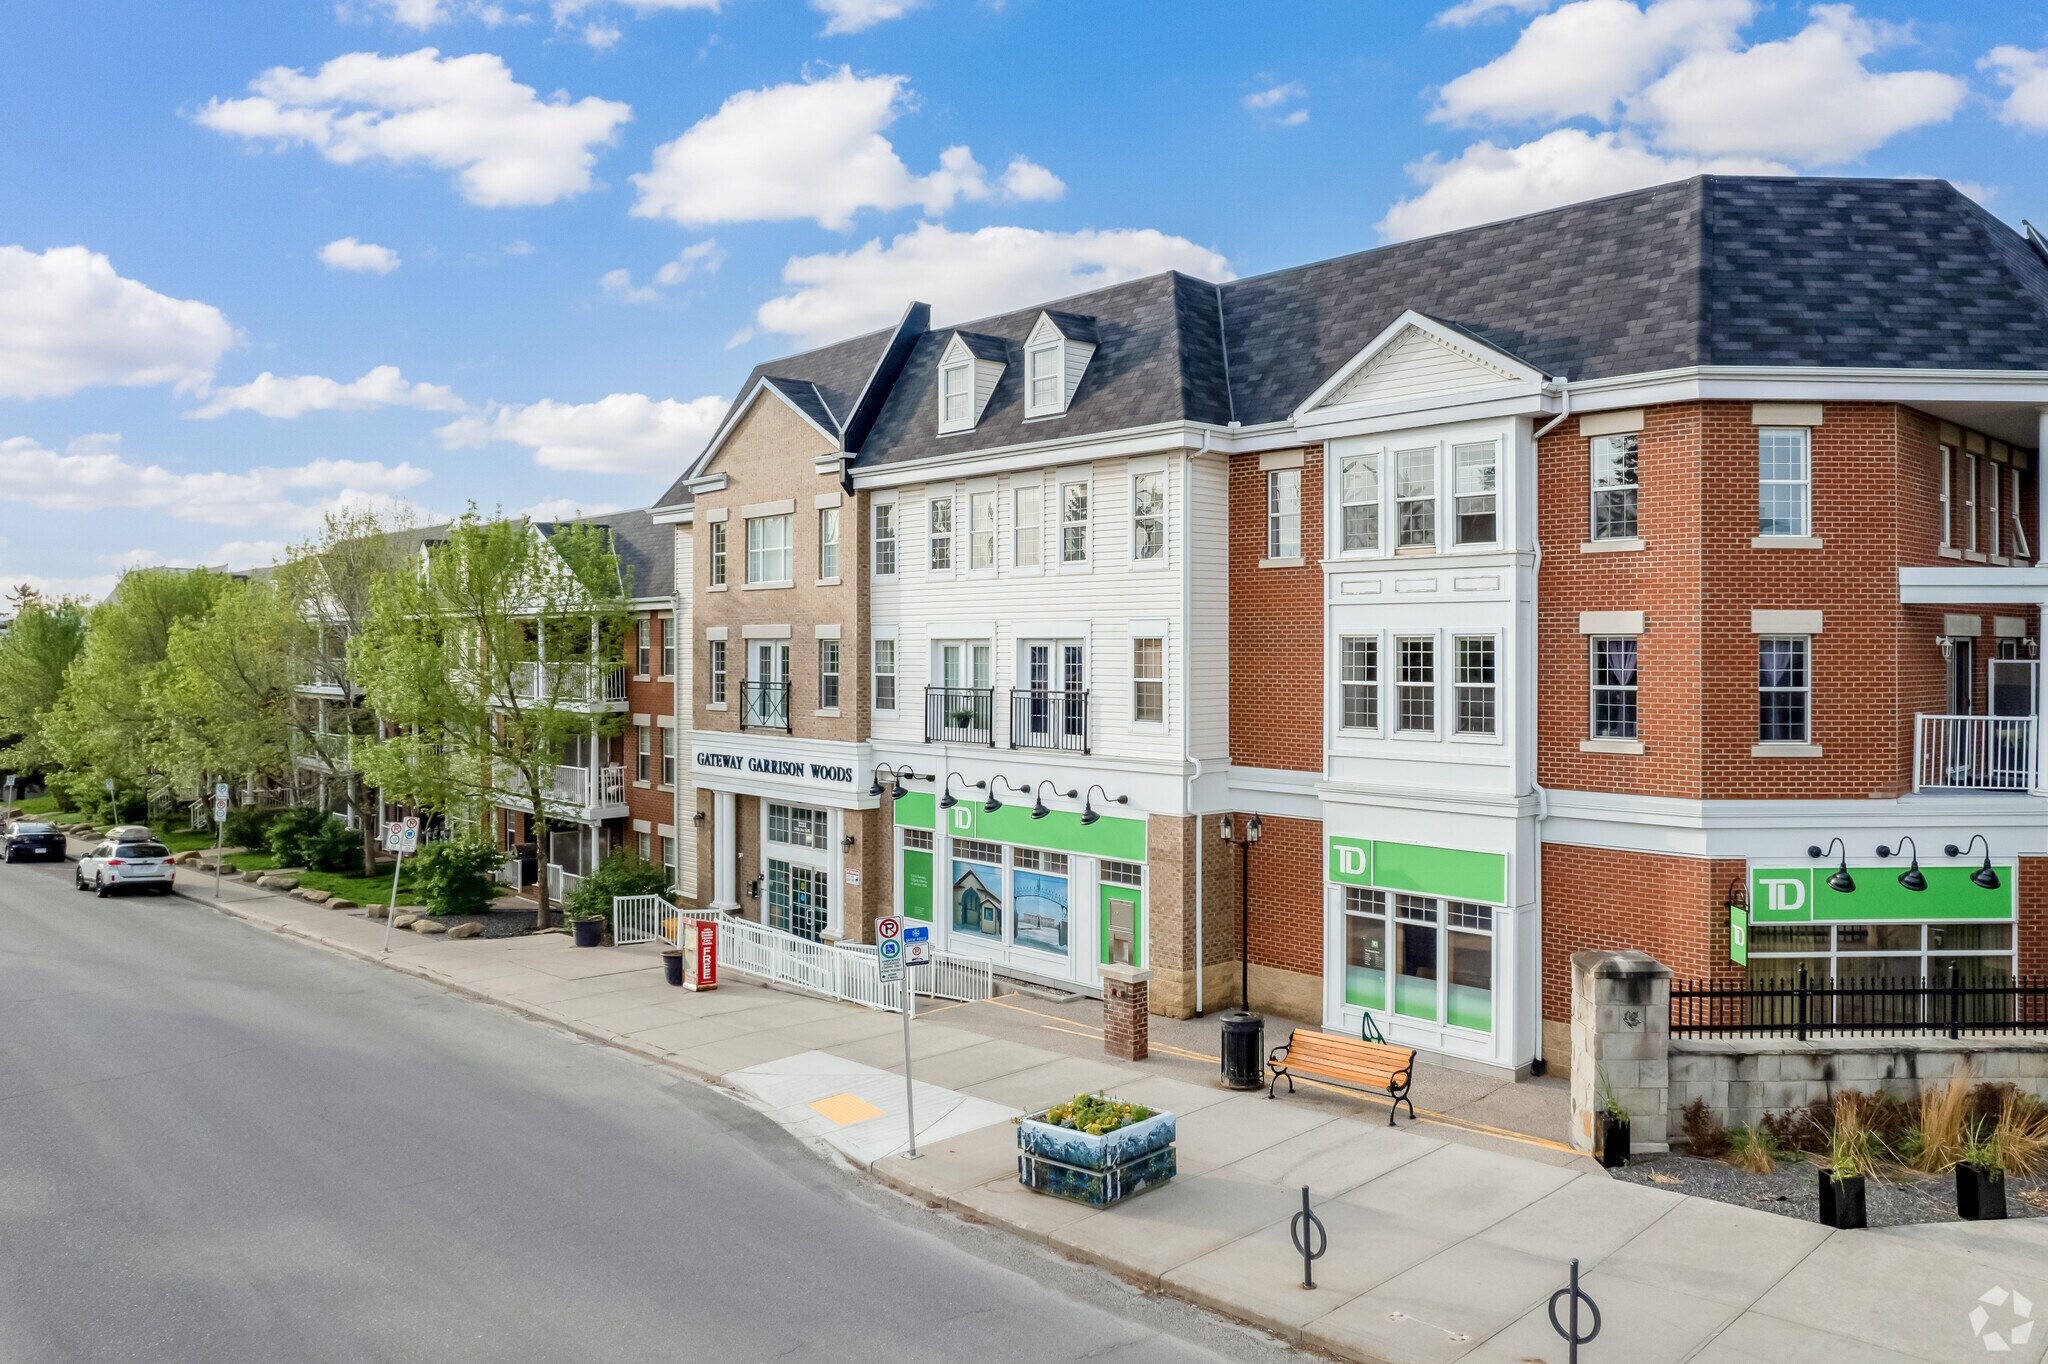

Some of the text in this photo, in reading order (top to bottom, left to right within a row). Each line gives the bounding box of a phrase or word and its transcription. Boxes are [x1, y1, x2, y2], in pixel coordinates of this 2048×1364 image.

[697, 752, 853, 783] GATEWAY GARRISON WOODS
[950, 805, 972, 830] TD
[1333, 844, 1366, 875] TD
[1759, 878, 1806, 910] TD
[1732, 924, 1745, 947] TD
[703, 946, 712, 980] FREE
